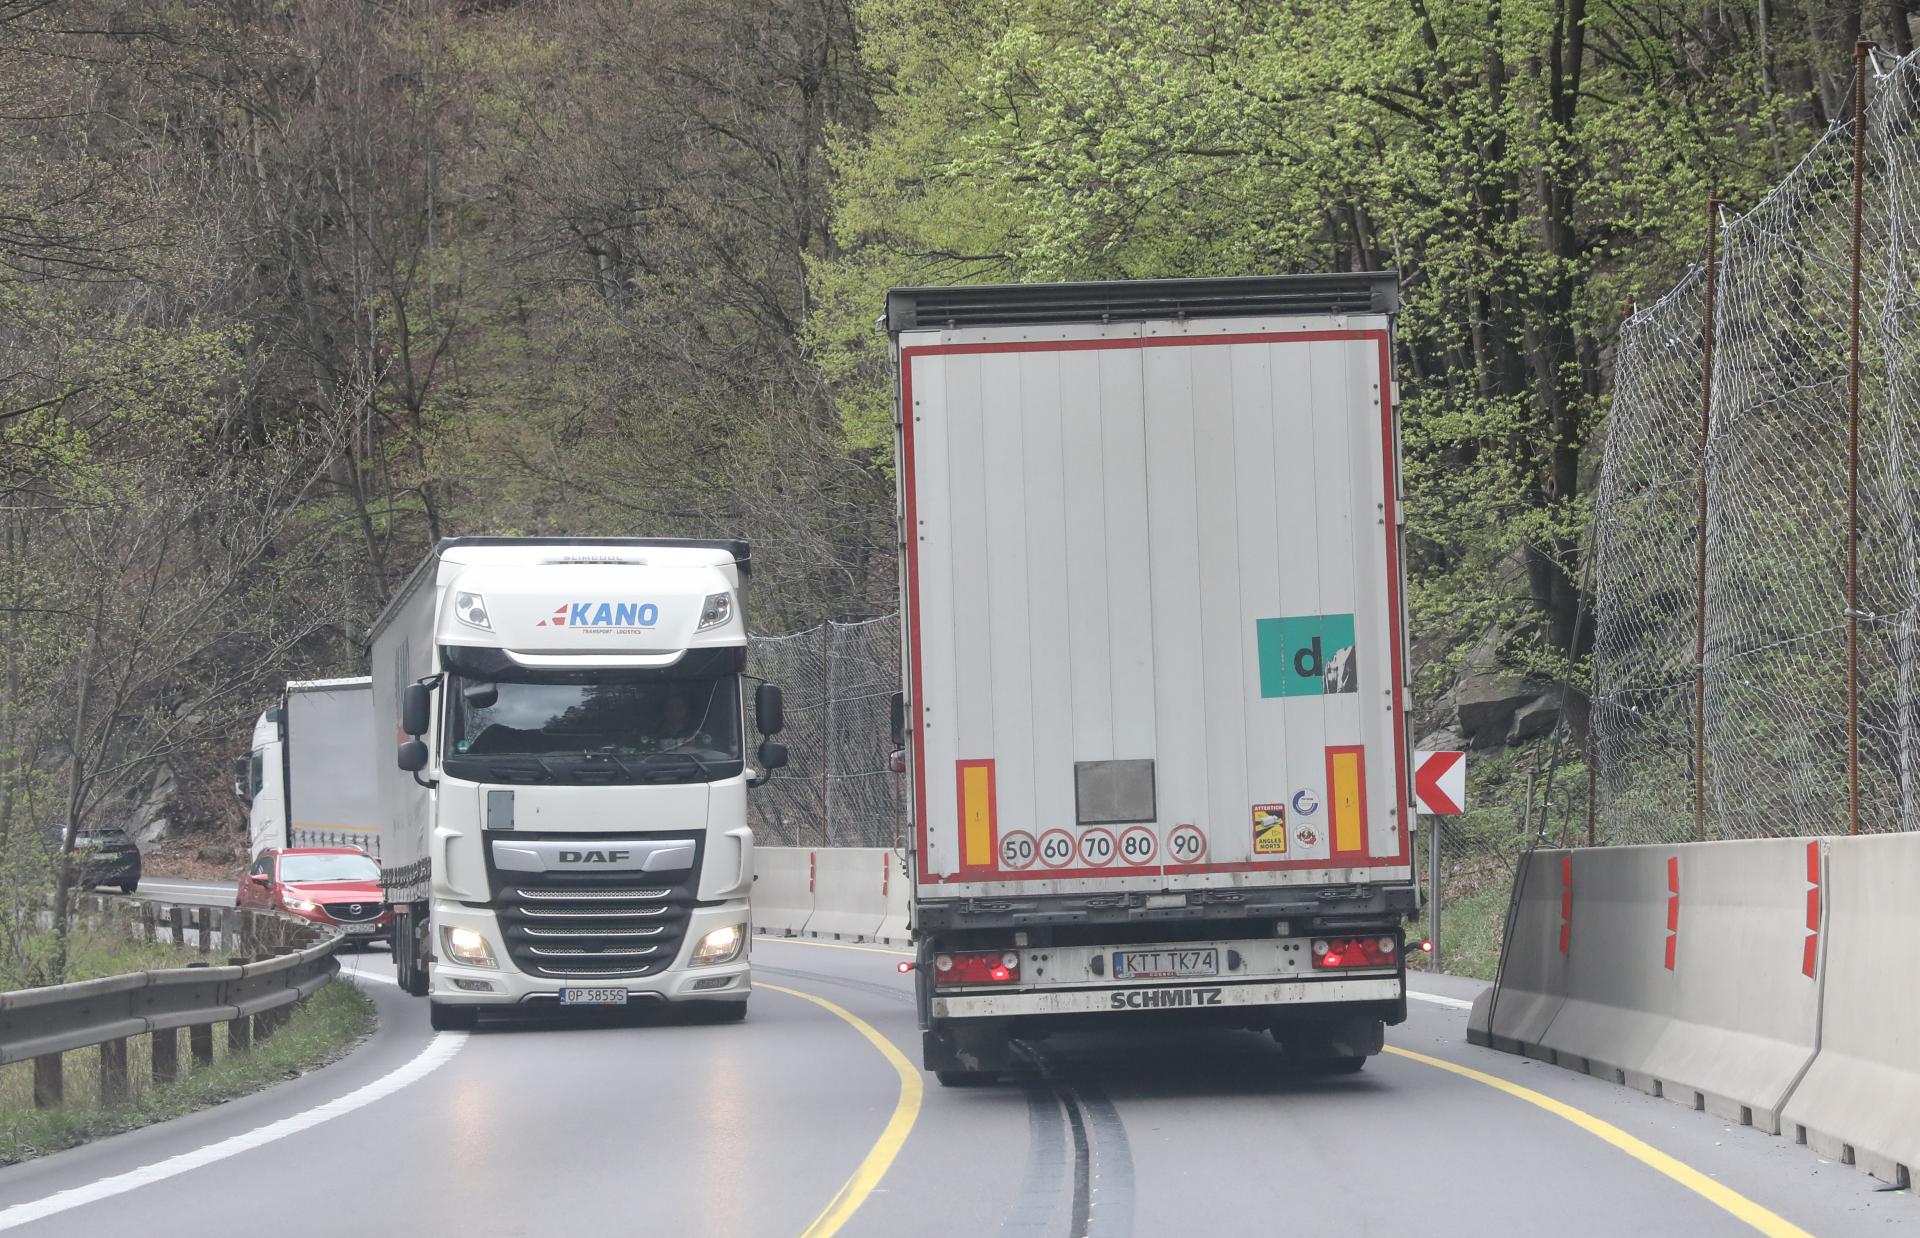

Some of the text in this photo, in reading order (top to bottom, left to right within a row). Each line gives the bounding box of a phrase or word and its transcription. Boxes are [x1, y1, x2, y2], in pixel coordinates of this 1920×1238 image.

[569, 603, 659, 626] KANO
[1005, 840, 1032, 860] 50
[1044, 838, 1070, 858] 60
[1085, 837, 1110, 857] 70
[1125, 836, 1151, 856] 80
[1174, 835, 1200, 855] 90
[559, 850, 630, 863] DAF
[1126, 951, 1212, 972] KTT TK74
[568, 989, 624, 1001] OP 5855S
[1110, 987, 1222, 1009] SCHMITZ
